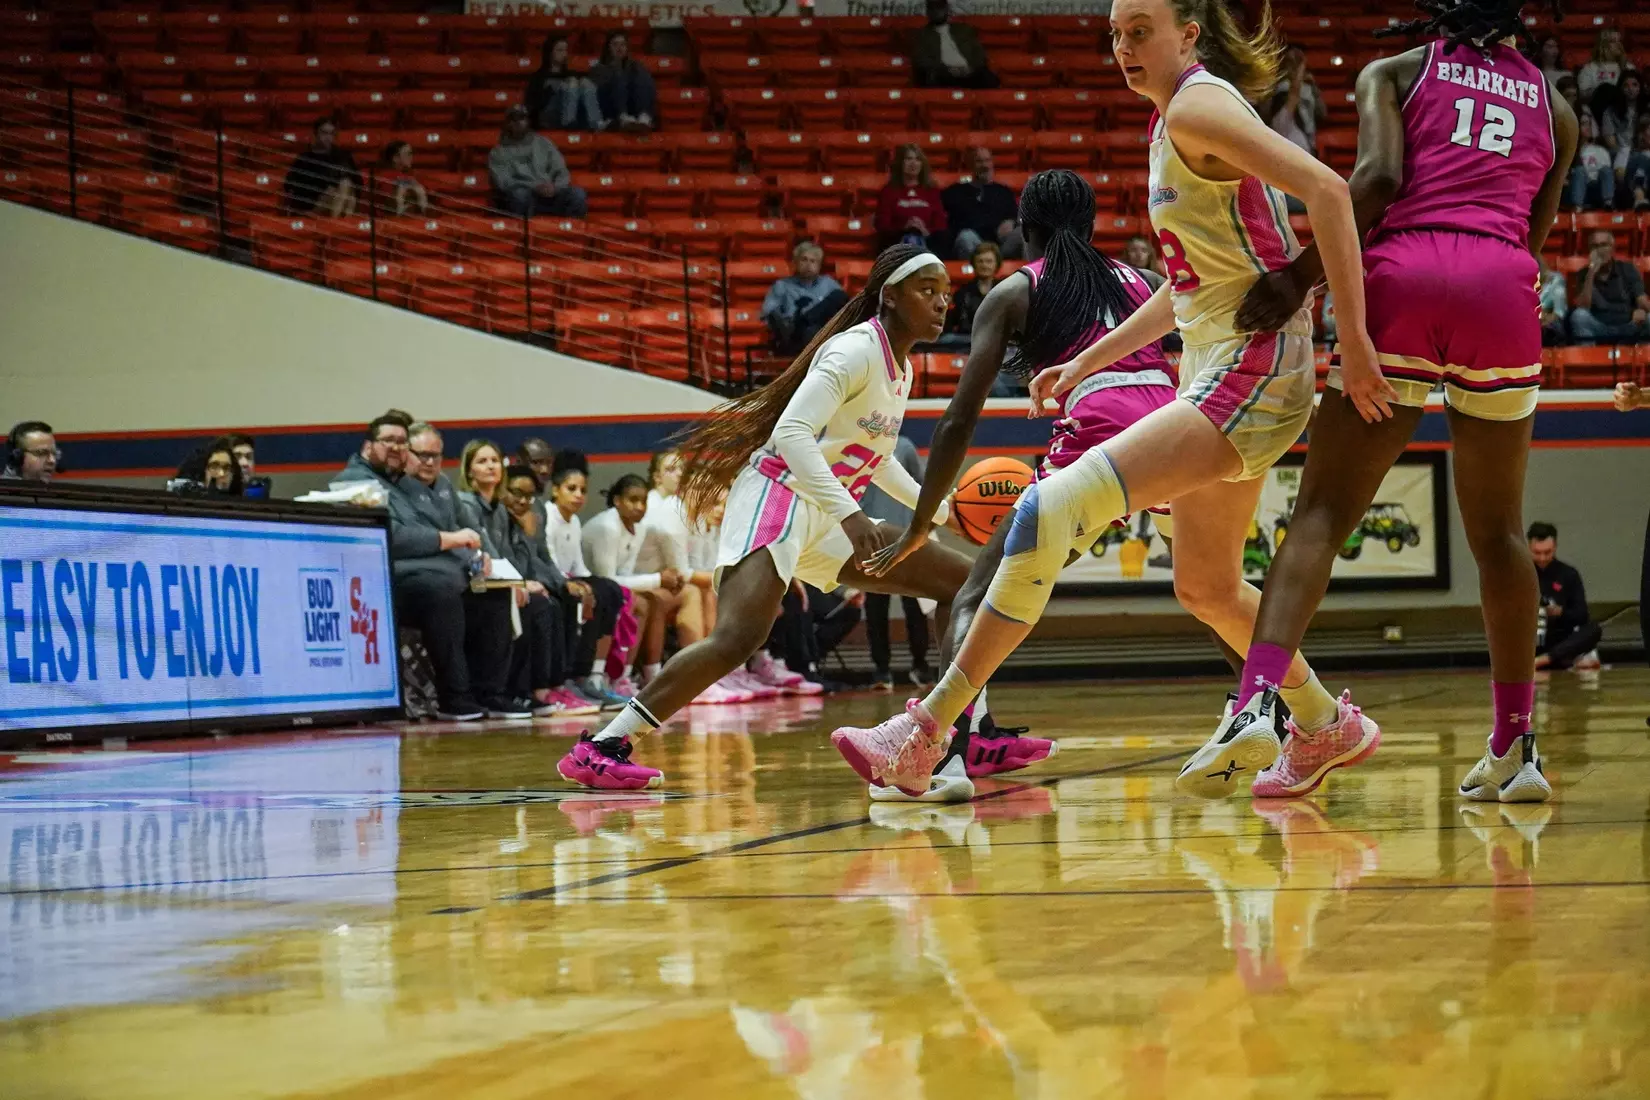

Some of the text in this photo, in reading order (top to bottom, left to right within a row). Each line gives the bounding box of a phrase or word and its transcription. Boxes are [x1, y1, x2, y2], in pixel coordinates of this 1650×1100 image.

[1437, 62, 1539, 108] BEARKATS
[1451, 97, 1516, 158] 12
[307, 578, 334, 609] BUD
[1, 559, 261, 684] EASY TO ENJOY
[305, 611, 341, 642] LIGHT
